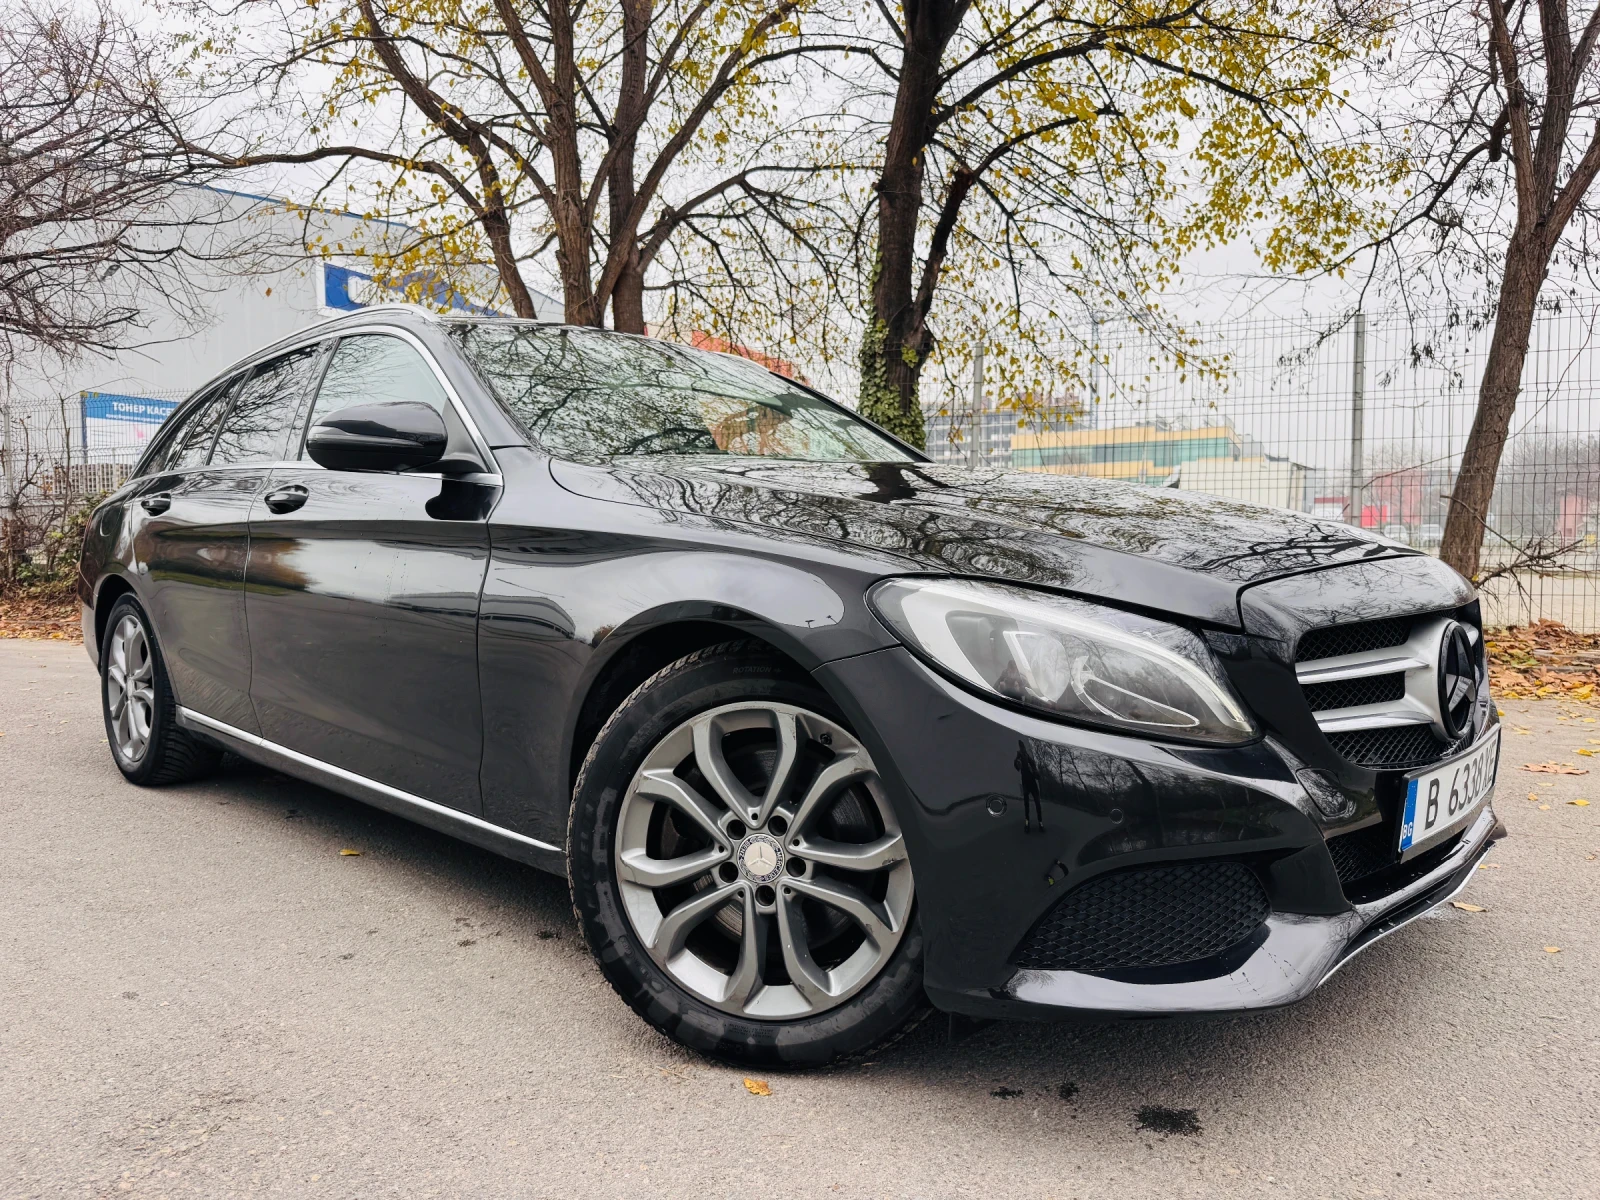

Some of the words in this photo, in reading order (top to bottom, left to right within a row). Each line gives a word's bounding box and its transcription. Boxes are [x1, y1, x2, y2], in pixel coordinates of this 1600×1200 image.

[112, 401, 145, 414] ТОНЕР
[732, 665, 772, 674] ROTATION
[1424, 777, 1440, 830] B
[1448, 752, 1484, 816] 6338
[1402, 822, 1413, 839] BG
